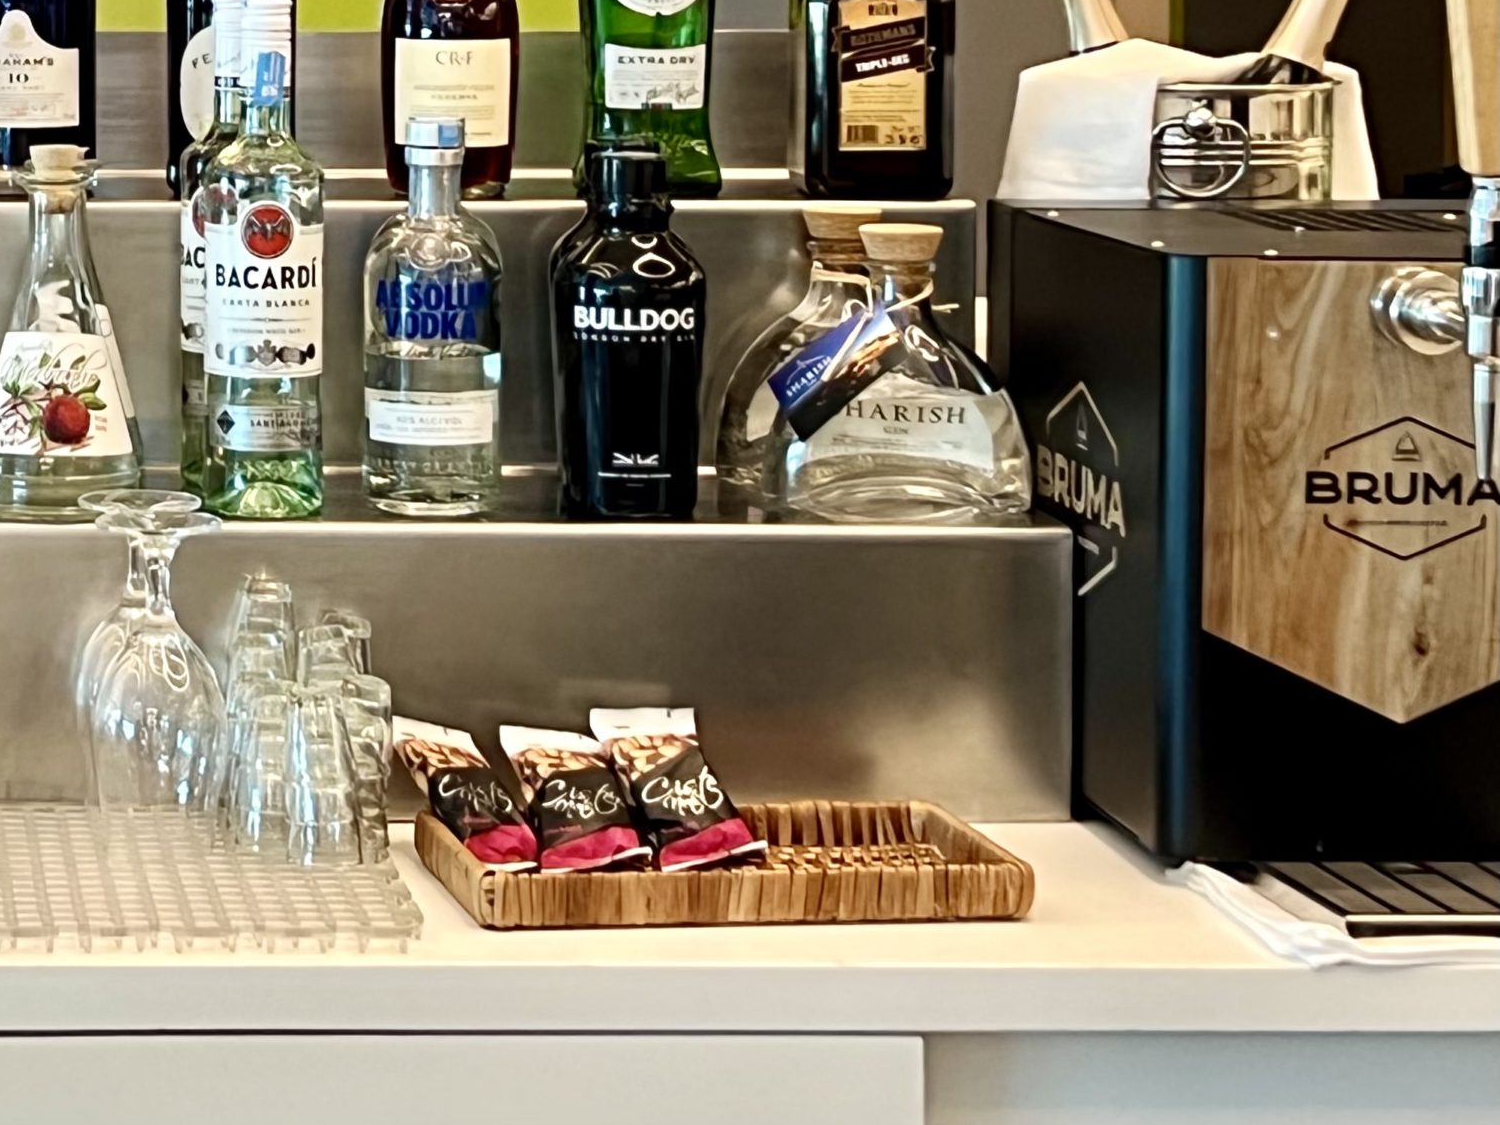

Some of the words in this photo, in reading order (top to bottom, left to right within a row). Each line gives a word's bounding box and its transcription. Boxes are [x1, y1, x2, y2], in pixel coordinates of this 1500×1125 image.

[617, 56, 665, 64] EXTRA
[670, 56, 695, 64] DRY
[9, 73, 29, 84] 10
[215, 257, 317, 290] BACARDÍ
[384, 311, 477, 340] VODKA
[573, 304, 695, 331] BULLDOG
[845, 400, 965, 425] HARISH
[1036, 443, 1127, 538] BRUMA
[1305, 470, 1500, 507] BRUMA
